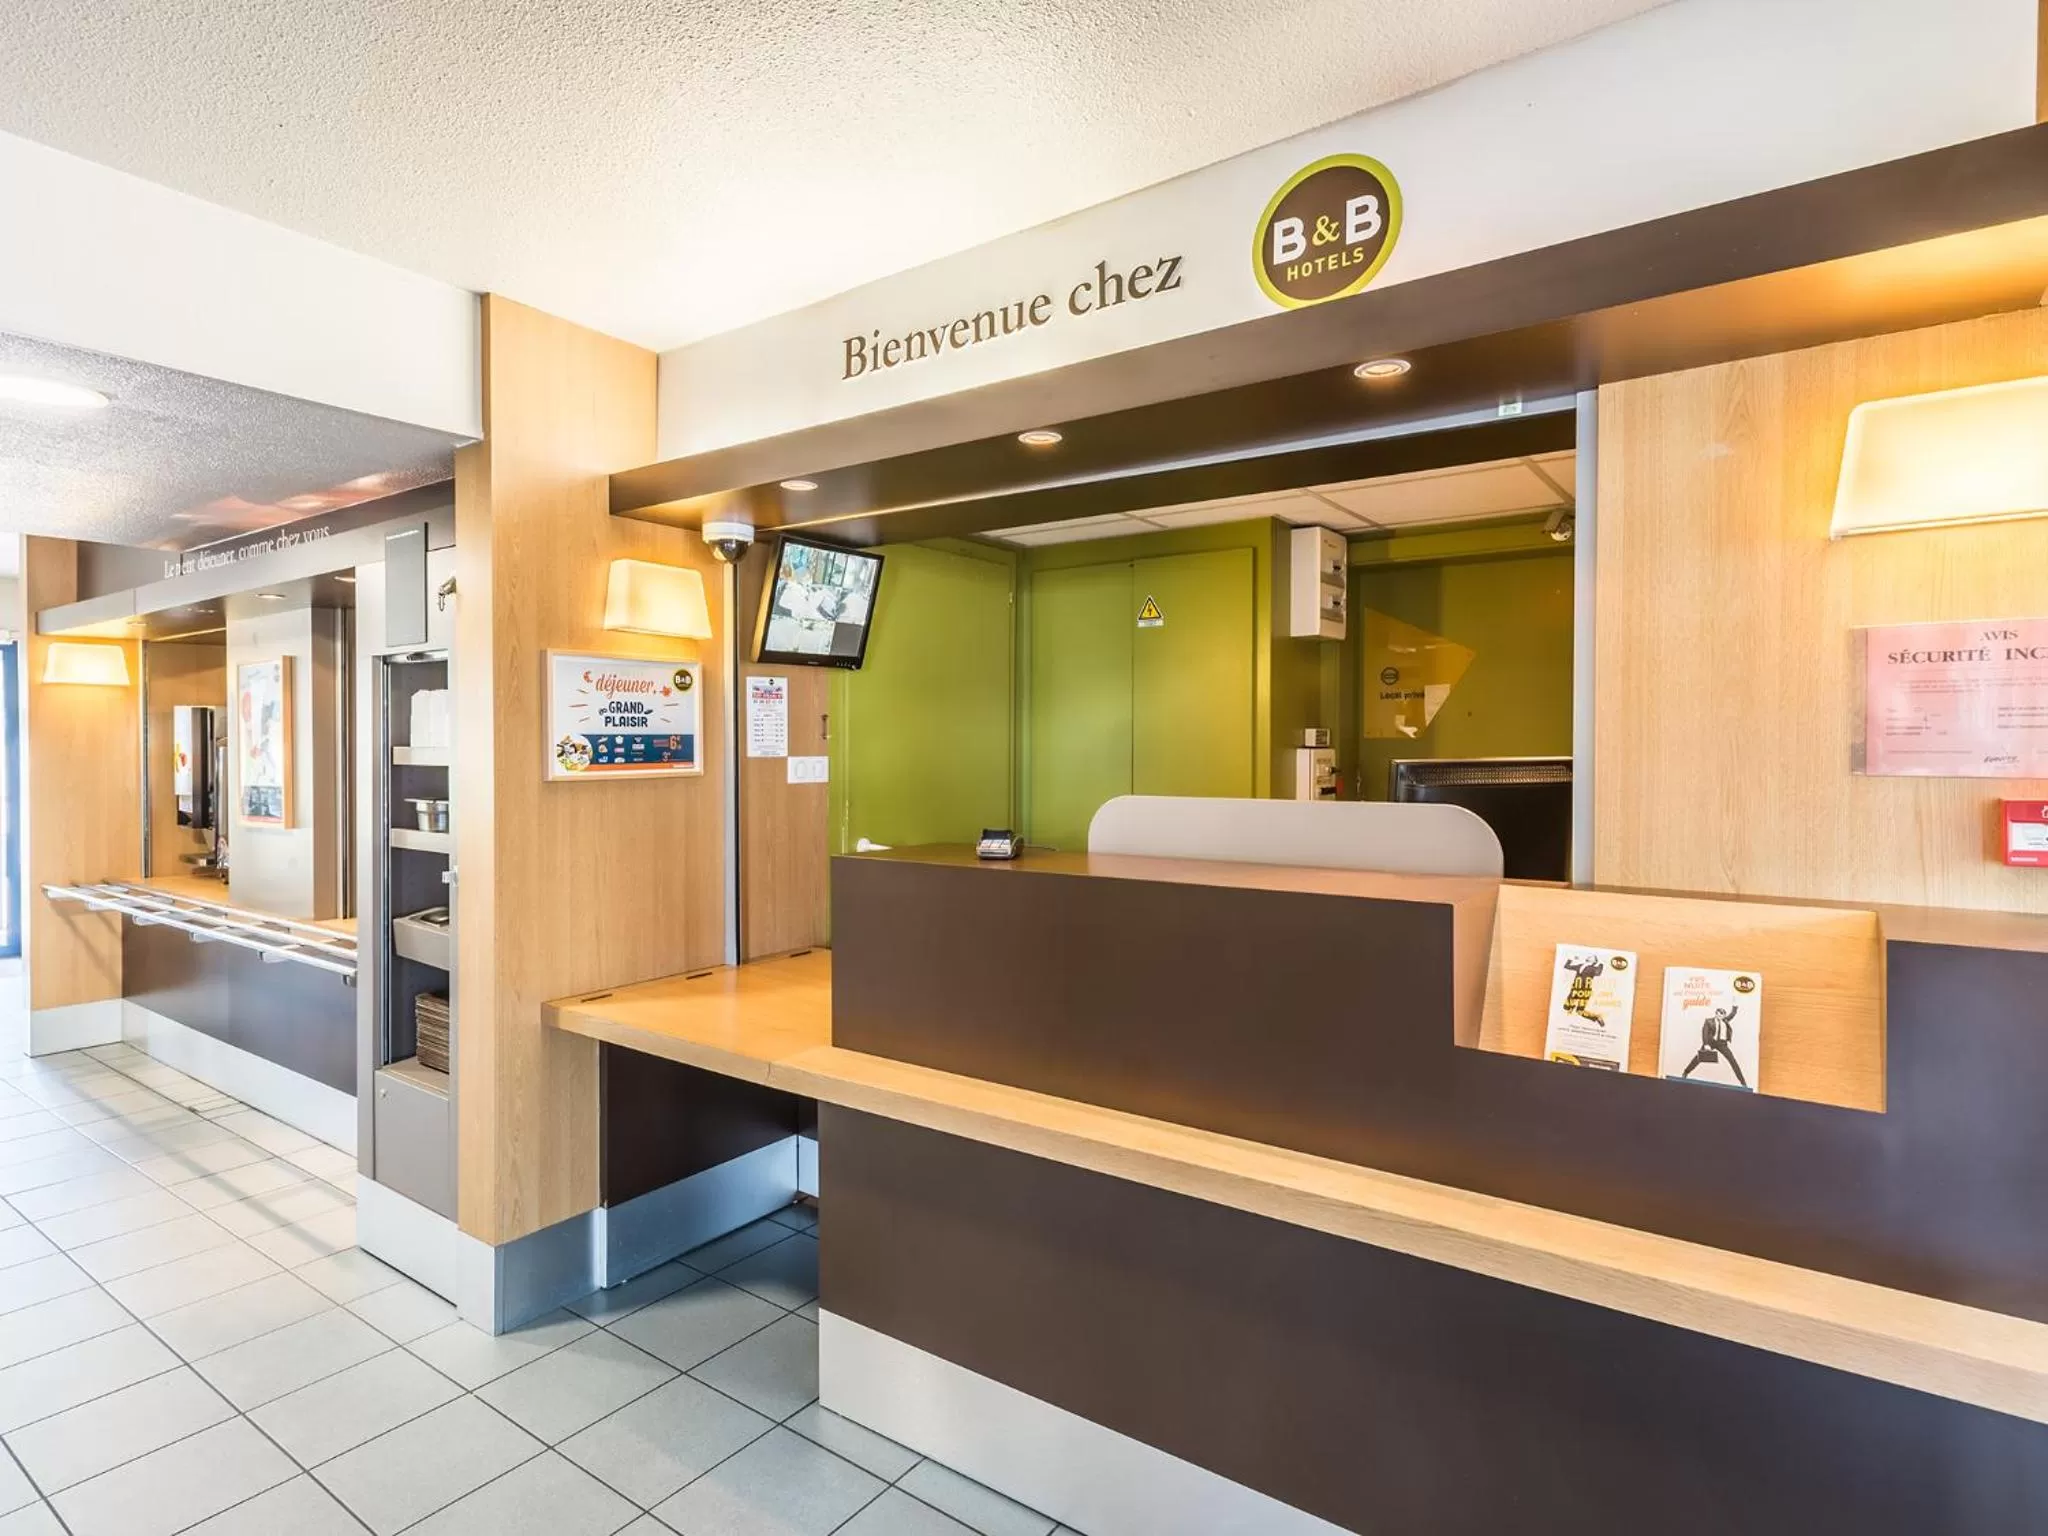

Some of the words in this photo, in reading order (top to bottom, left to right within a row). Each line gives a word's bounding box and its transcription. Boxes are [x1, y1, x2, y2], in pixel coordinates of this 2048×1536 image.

[1273, 194, 1382, 266] B&B
[1286, 247, 1365, 282] HOTELS
[841, 292, 1052, 381] Bienvenue
[1067, 255, 1183, 317] chez
[238, 539, 274, 561] comme
[276, 529, 301, 552] chez
[1979, 629, 2019, 641] AVIS
[1888, 645, 1991, 665] SÉCURITÉ
[1380, 691, 1402, 700] Local
[608, 701, 644, 715] GRAND
[605, 716, 648, 729] PLAISIR
